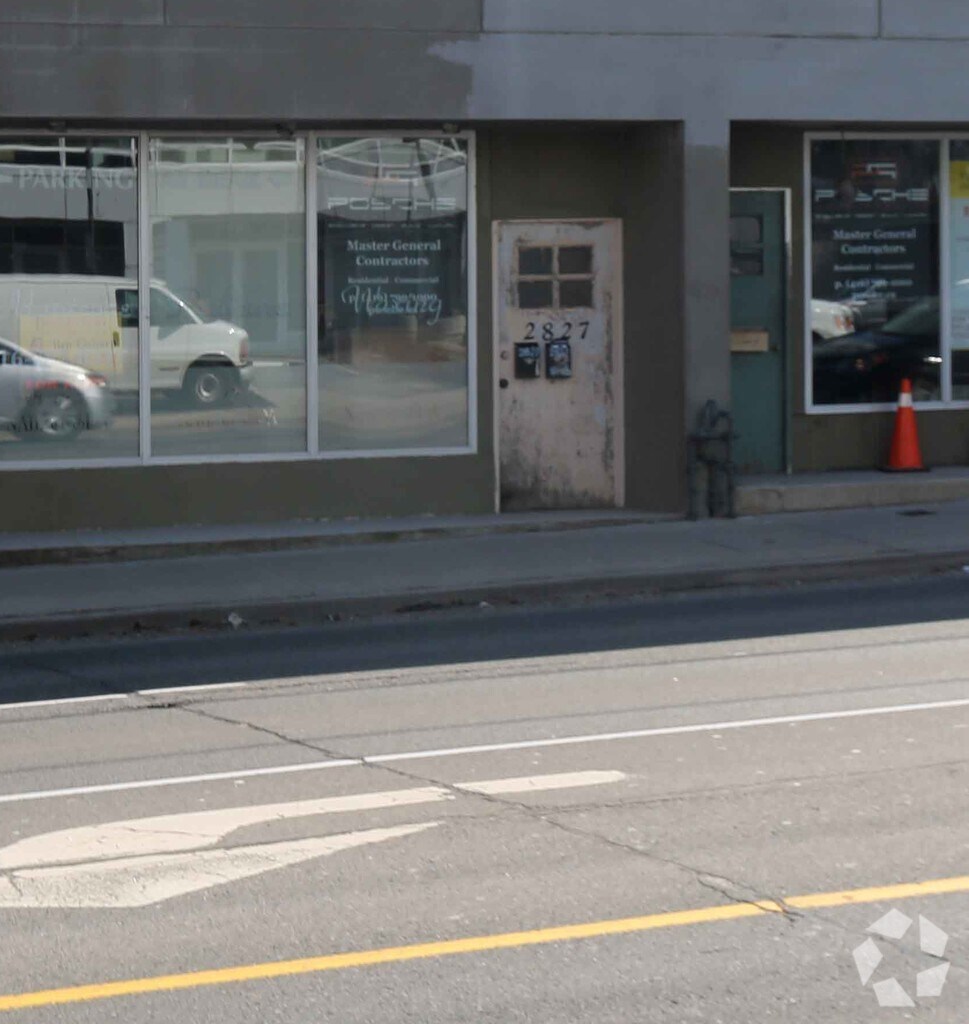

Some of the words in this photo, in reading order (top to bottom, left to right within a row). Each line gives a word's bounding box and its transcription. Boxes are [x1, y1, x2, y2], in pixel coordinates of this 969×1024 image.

[833, 230, 870, 240] Master
[873, 228, 916, 240] General
[347, 240, 389, 251] Master
[392, 239, 441, 251] General
[840, 244, 906, 254] Contractors
[355, 255, 429, 266] Contractors
[524, 320, 589, 341] 2827
